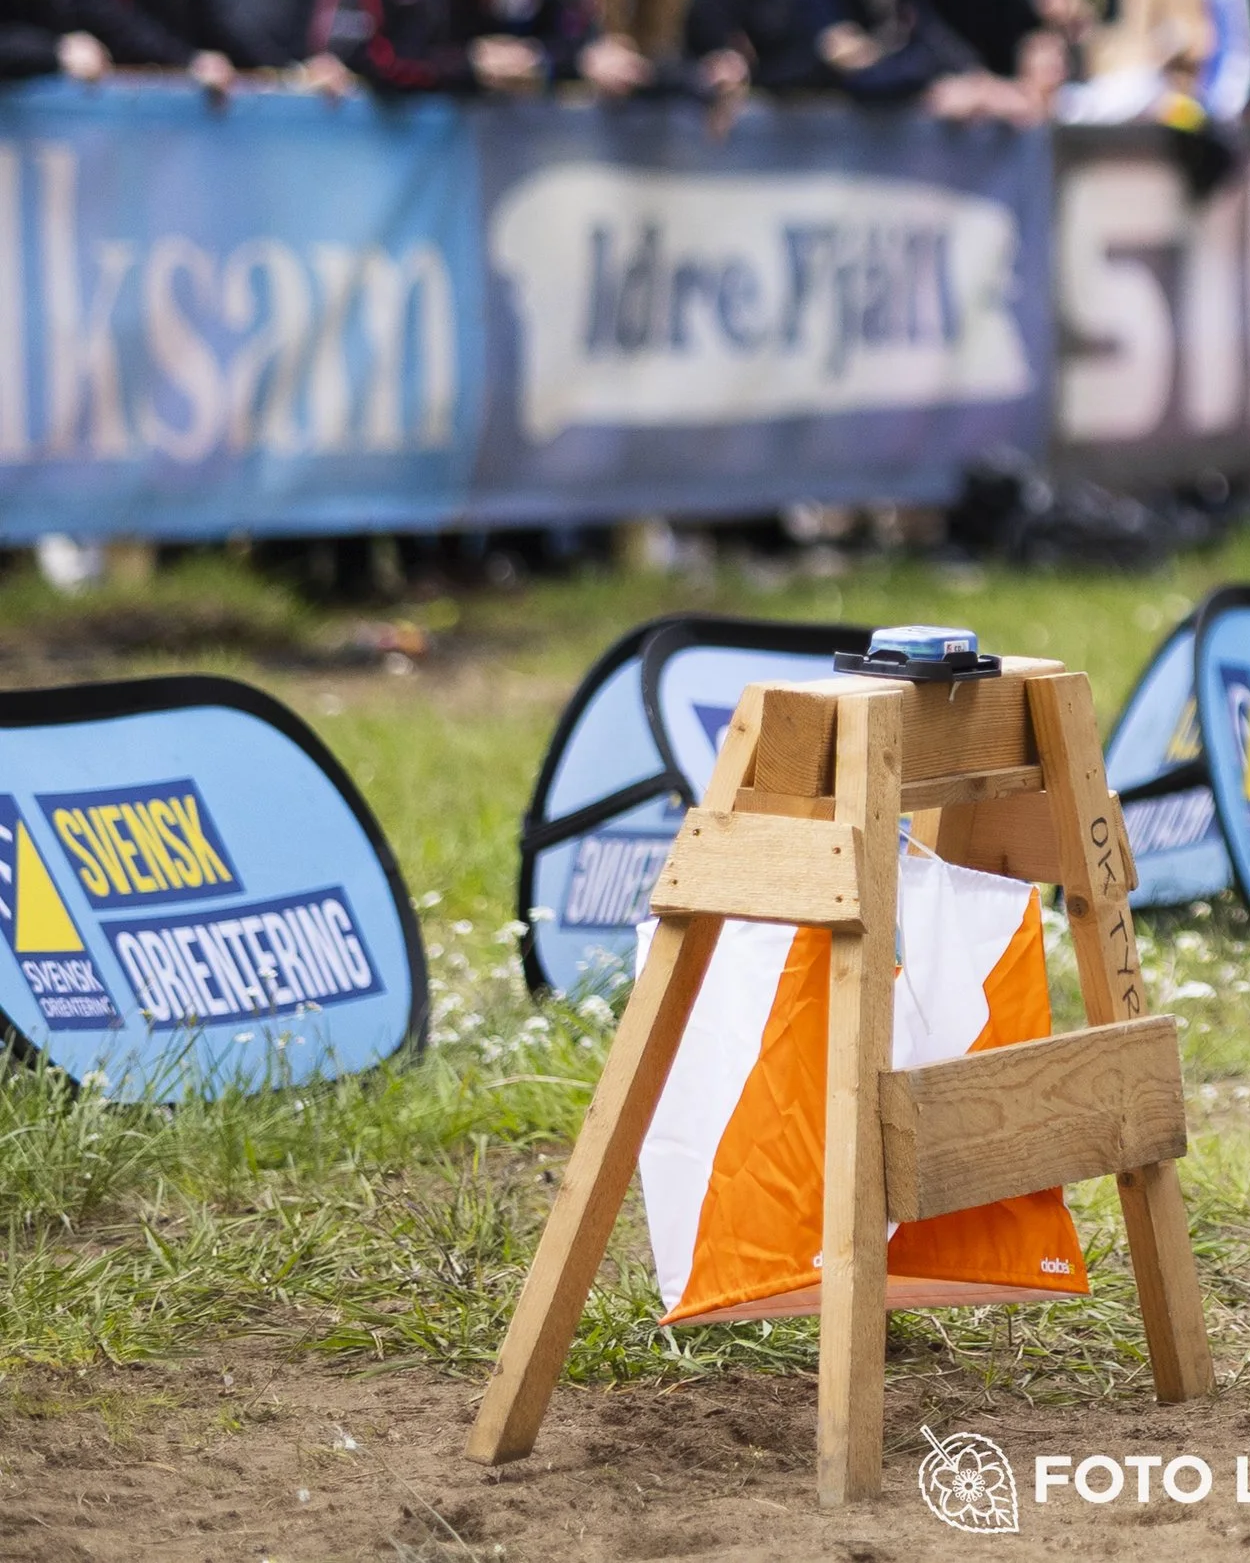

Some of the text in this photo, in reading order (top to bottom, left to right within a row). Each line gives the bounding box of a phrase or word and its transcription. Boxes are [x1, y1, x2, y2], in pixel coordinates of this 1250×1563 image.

[53, 795, 232, 897] SVENSK
[1090, 817, 1116, 895] OK
[22, 959, 104, 993] SVENSK
[115, 898, 371, 1022] ORIENTERING
[40, 996, 116, 1018] ORIENTERING
